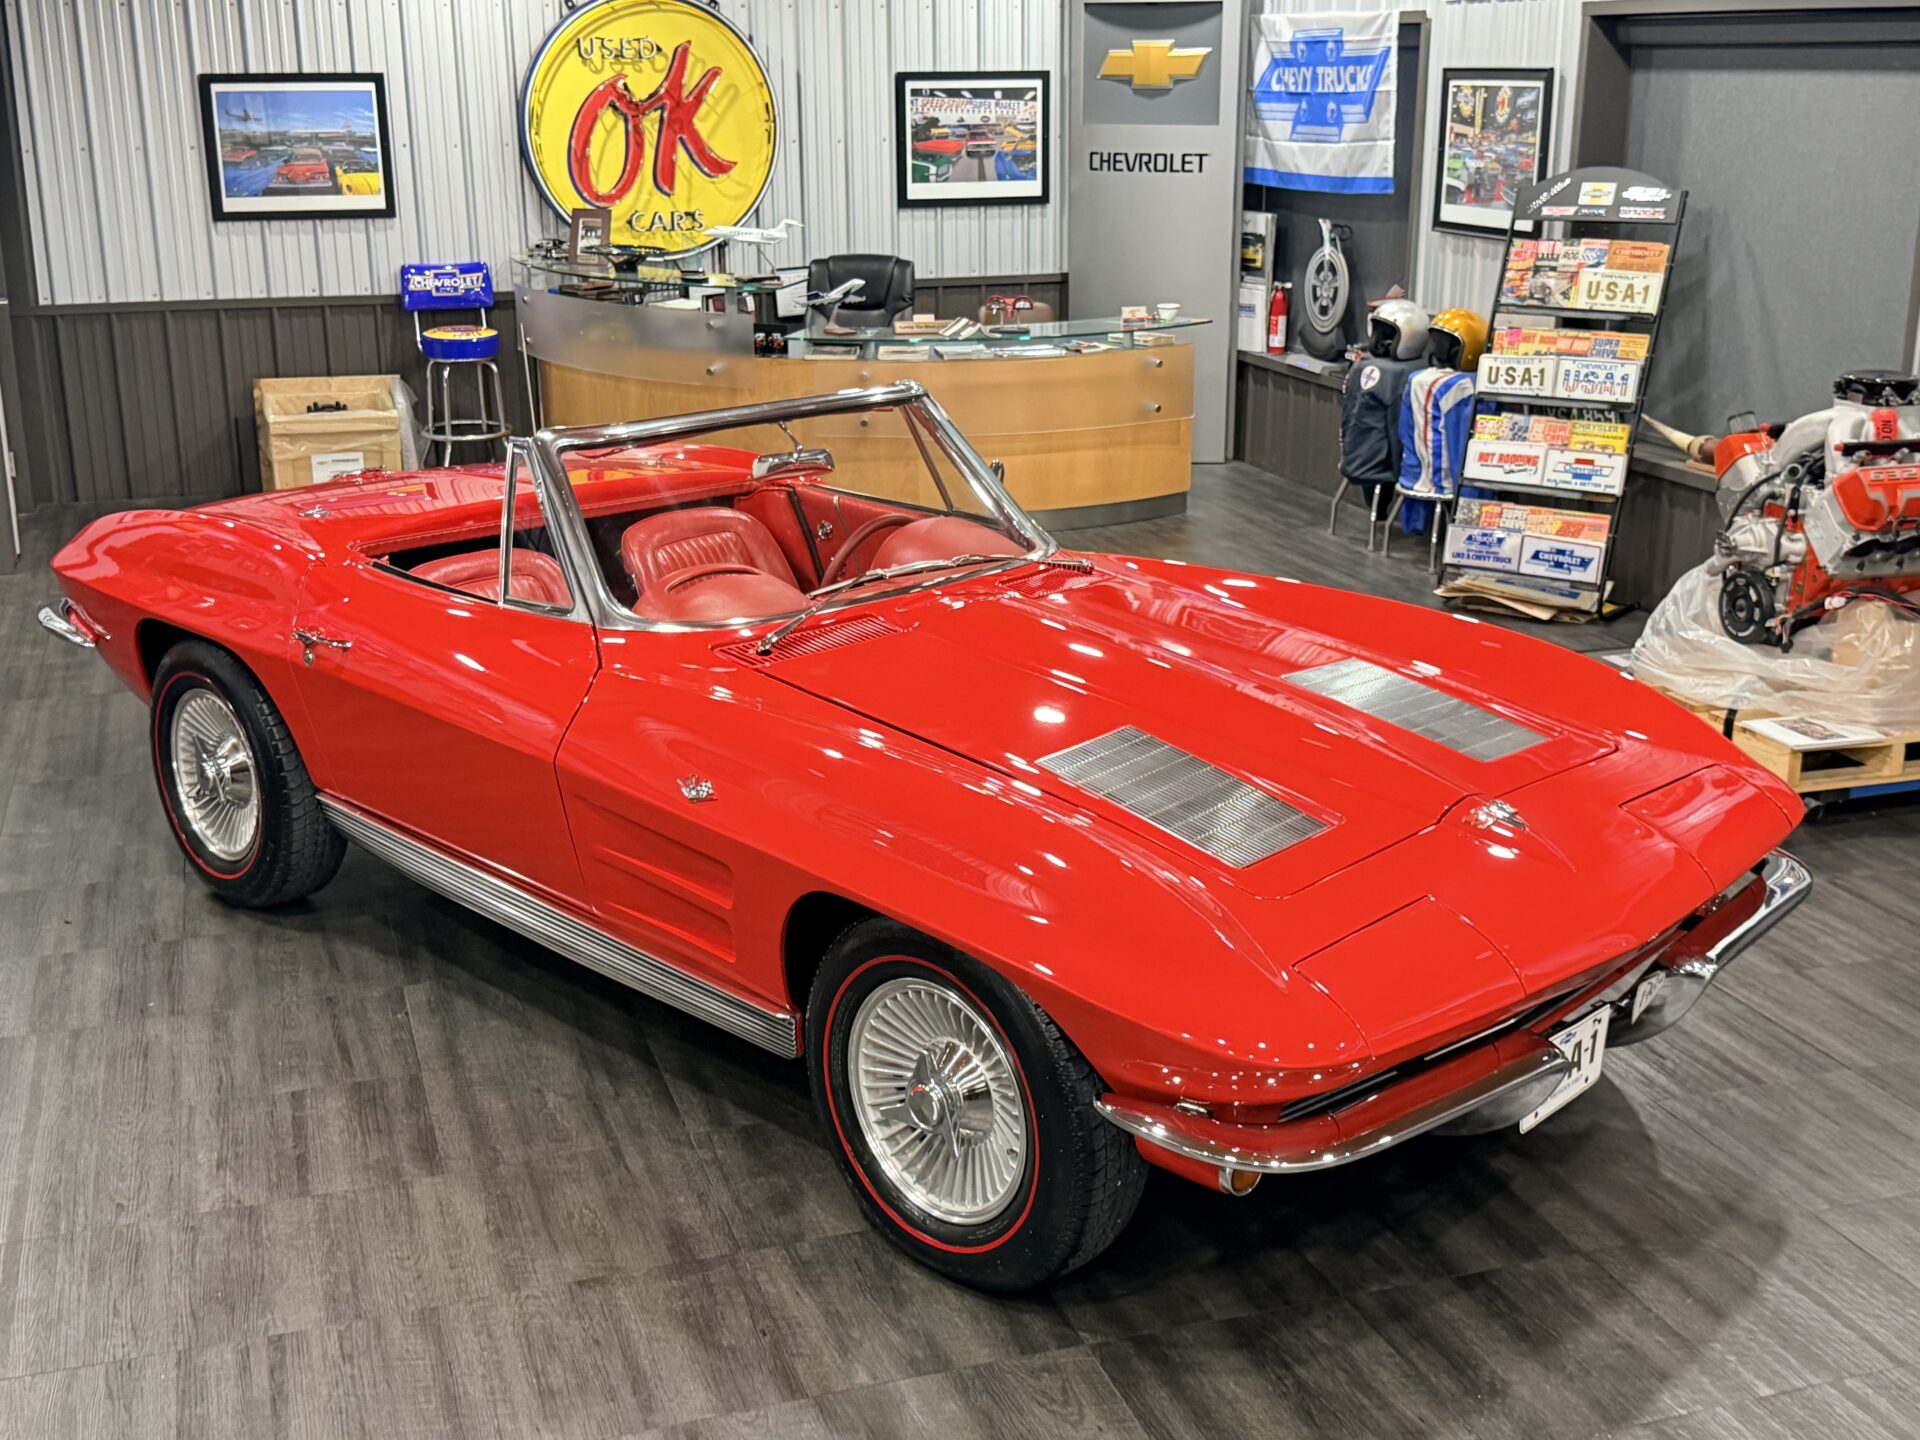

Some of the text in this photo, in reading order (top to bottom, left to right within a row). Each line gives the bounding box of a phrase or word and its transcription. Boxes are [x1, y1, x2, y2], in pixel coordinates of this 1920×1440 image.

[577, 36, 657, 60] USED
[1270, 65, 1312, 91] CHEVY
[568, 40, 738, 208] OK
[1089, 152, 1209, 173] CHEVROLET
[629, 210, 705, 232] CARS
[413, 276, 479, 289] CHEVROLET
[1593, 338, 1620, 349] SUPER
[1572, 422, 1619, 433] CHRYSLER
[1477, 452, 1494, 463] HOT
[1563, 464, 1604, 475] Chevrolet
[1451, 552, 1465, 560] LIKE
[1471, 554, 1492, 562] CHEVY
[1492, 556, 1513, 565] TRUCK
[1538, 551, 1582, 566] CHEVROLET
